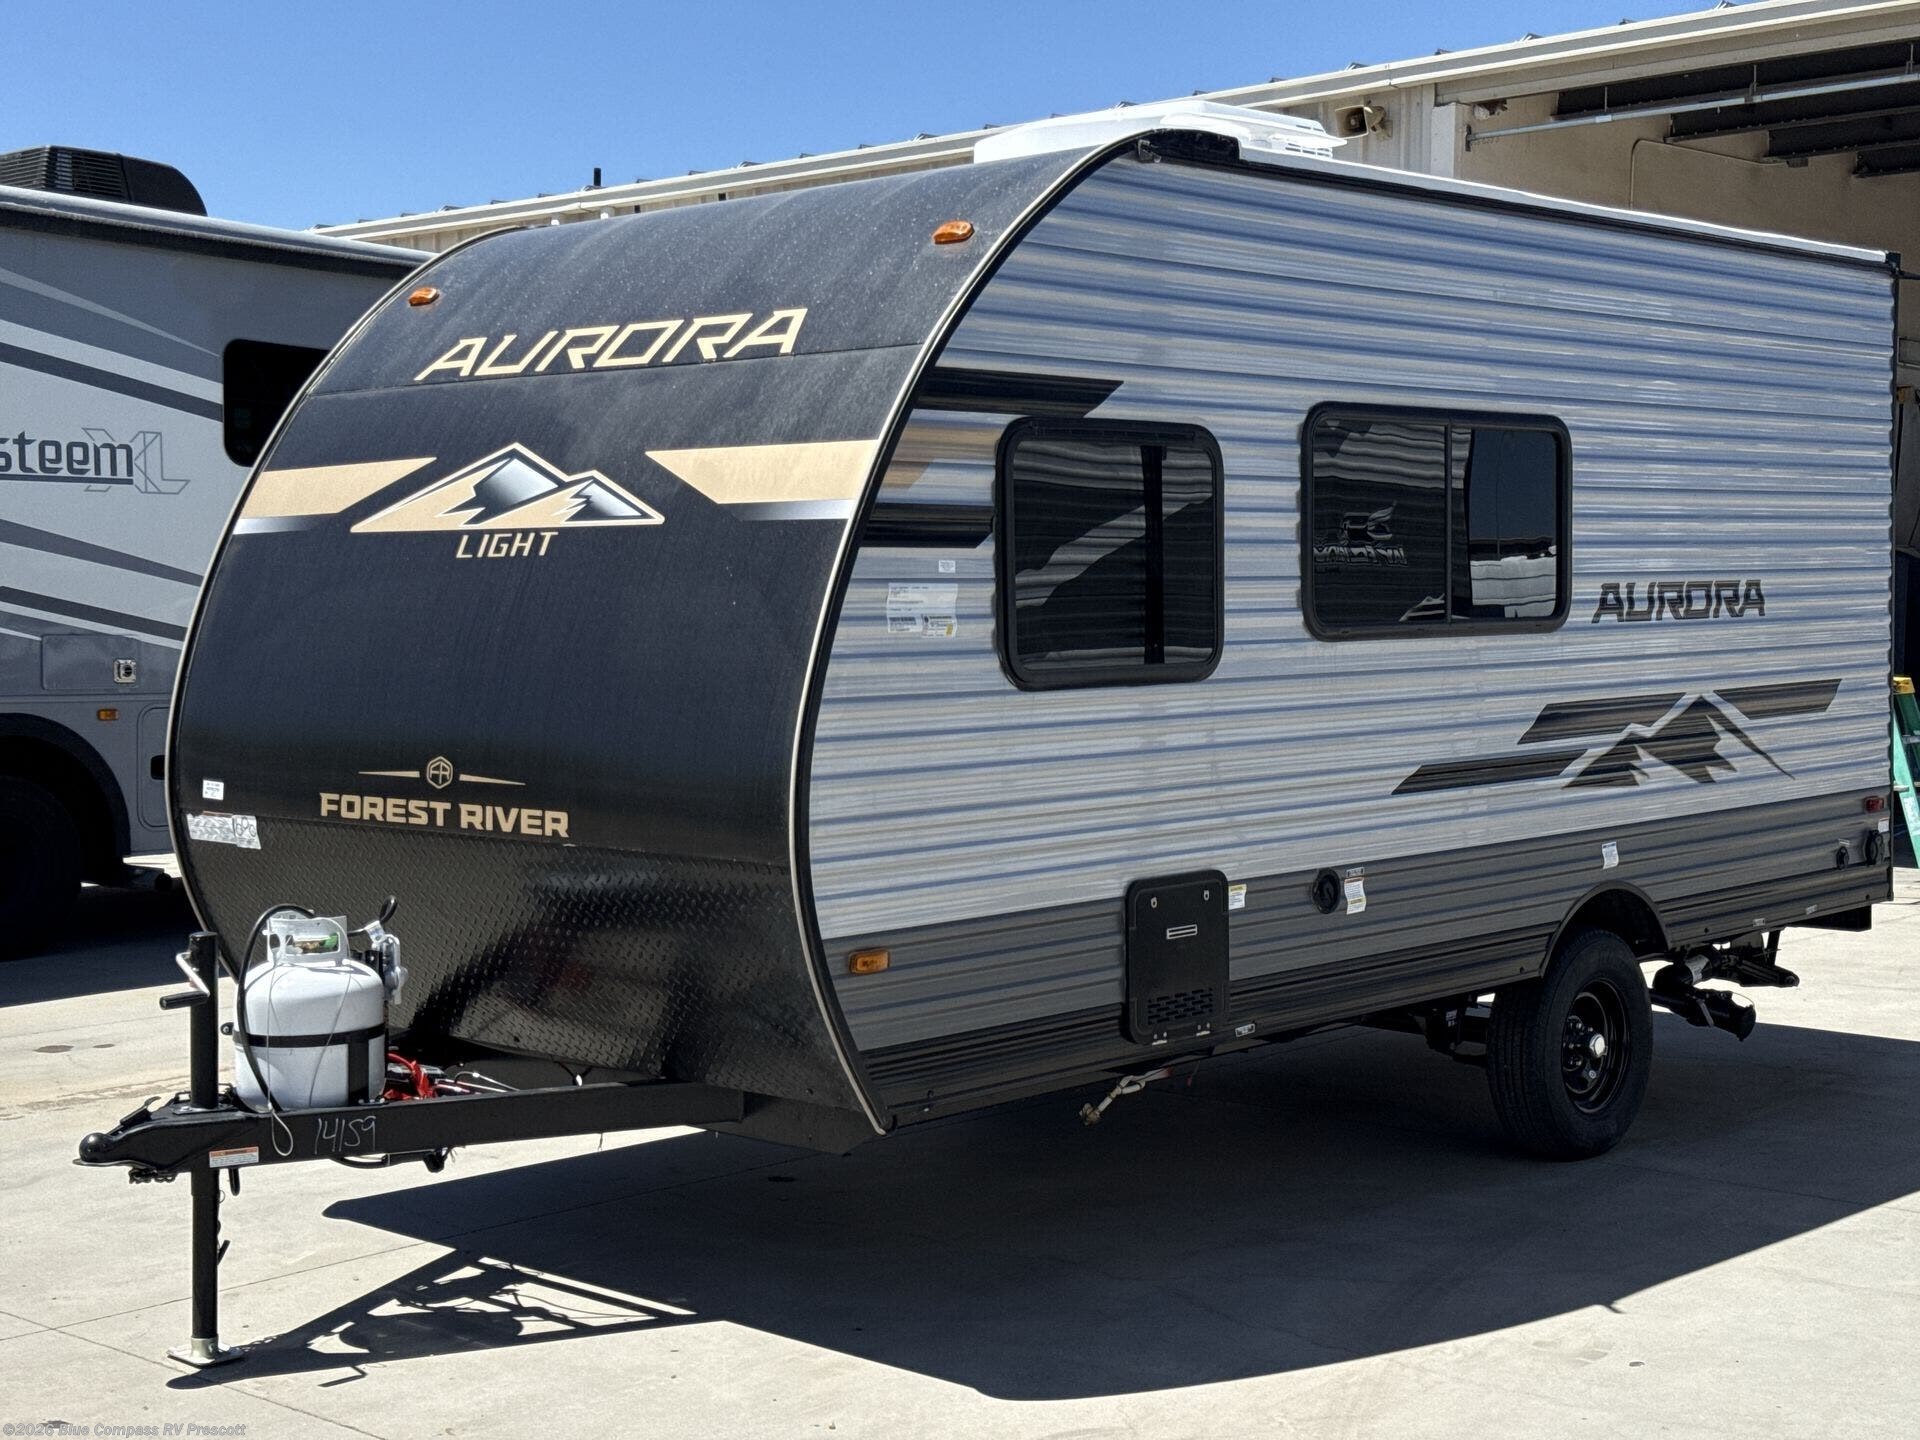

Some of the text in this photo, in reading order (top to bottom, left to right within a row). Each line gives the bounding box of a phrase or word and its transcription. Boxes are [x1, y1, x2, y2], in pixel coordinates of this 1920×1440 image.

[414, 308, 808, 381] AURORA
[455, 531, 559, 559] LIGHT
[1592, 579, 1765, 624] AURORA
[319, 792, 569, 838] FOREST RIVER
[314, 1115, 377, 1155] 14159
